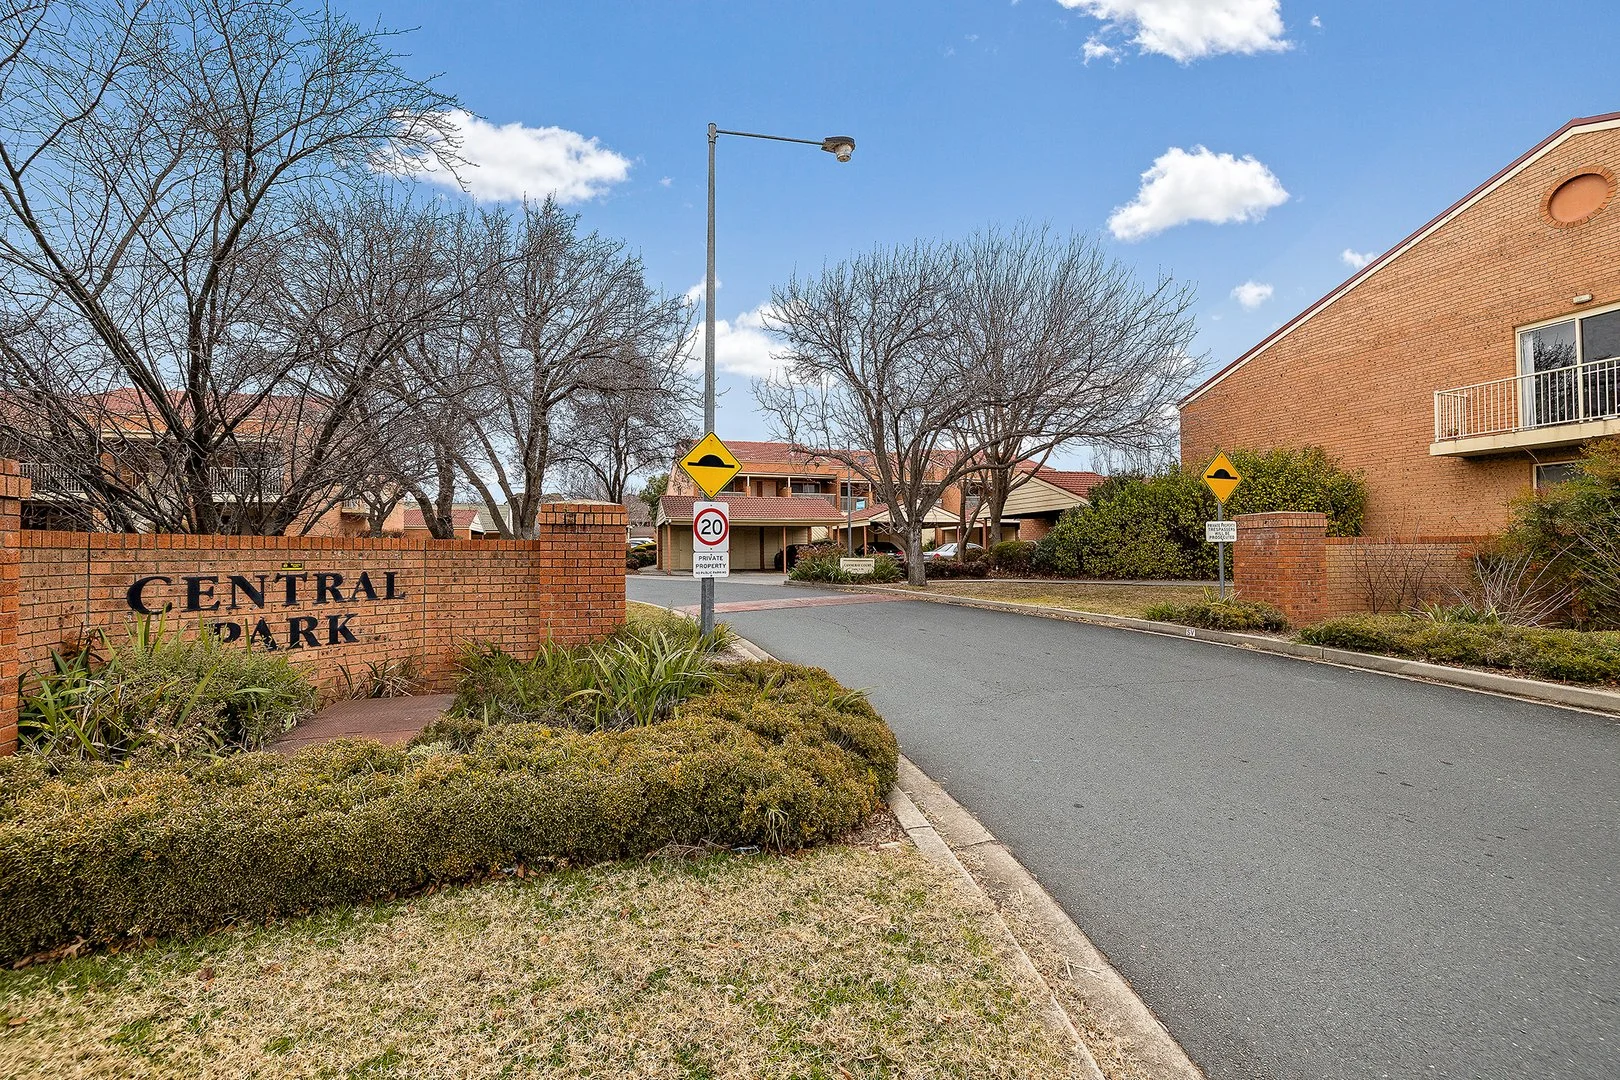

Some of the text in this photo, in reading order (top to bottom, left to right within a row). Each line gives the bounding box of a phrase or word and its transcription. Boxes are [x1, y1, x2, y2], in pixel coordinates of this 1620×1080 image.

[701, 519, 723, 535] 20
[126, 571, 407, 614] CENTRAL
[214, 613, 360, 651] PARK
